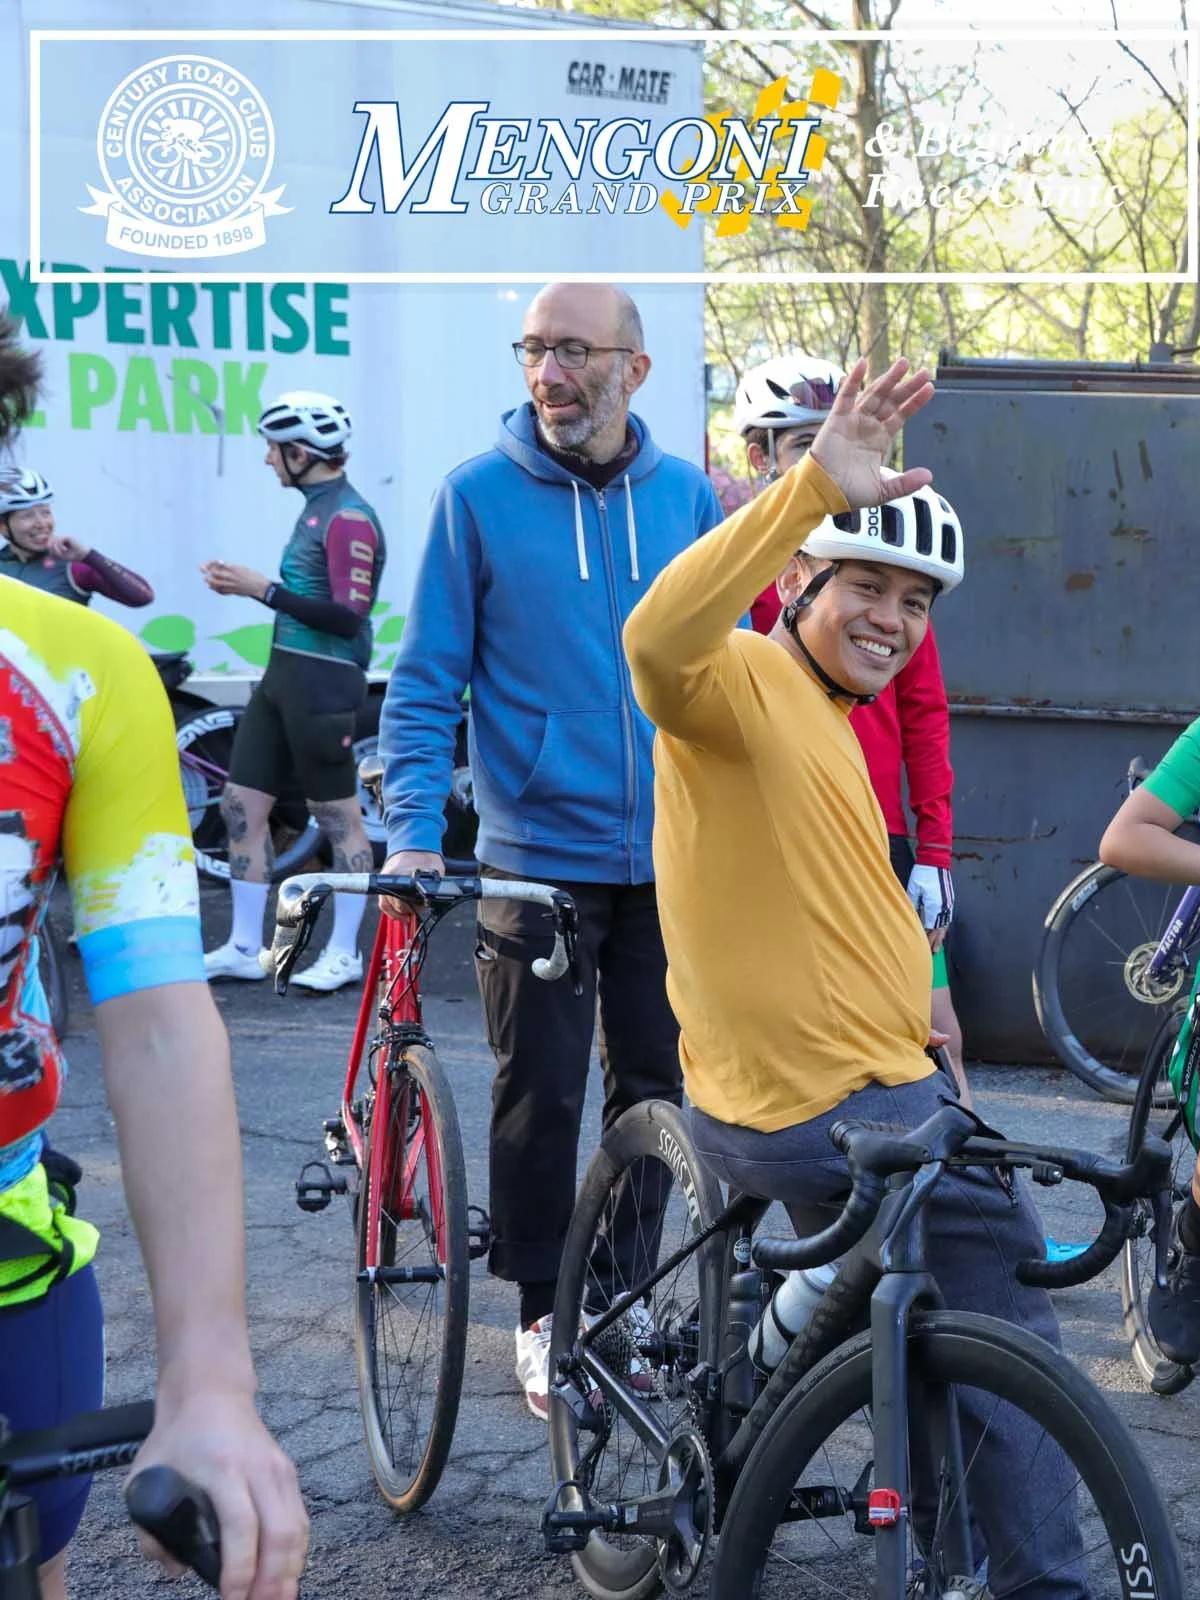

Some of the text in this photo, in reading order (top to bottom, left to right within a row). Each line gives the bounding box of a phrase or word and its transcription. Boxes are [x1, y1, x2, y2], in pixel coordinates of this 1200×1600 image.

[567, 61, 671, 95] CAR MATE
[68, 352, 269, 436] PARK
[1160, 919, 1184, 955] FACTOR
[658, 1128, 688, 1182] SWISS
